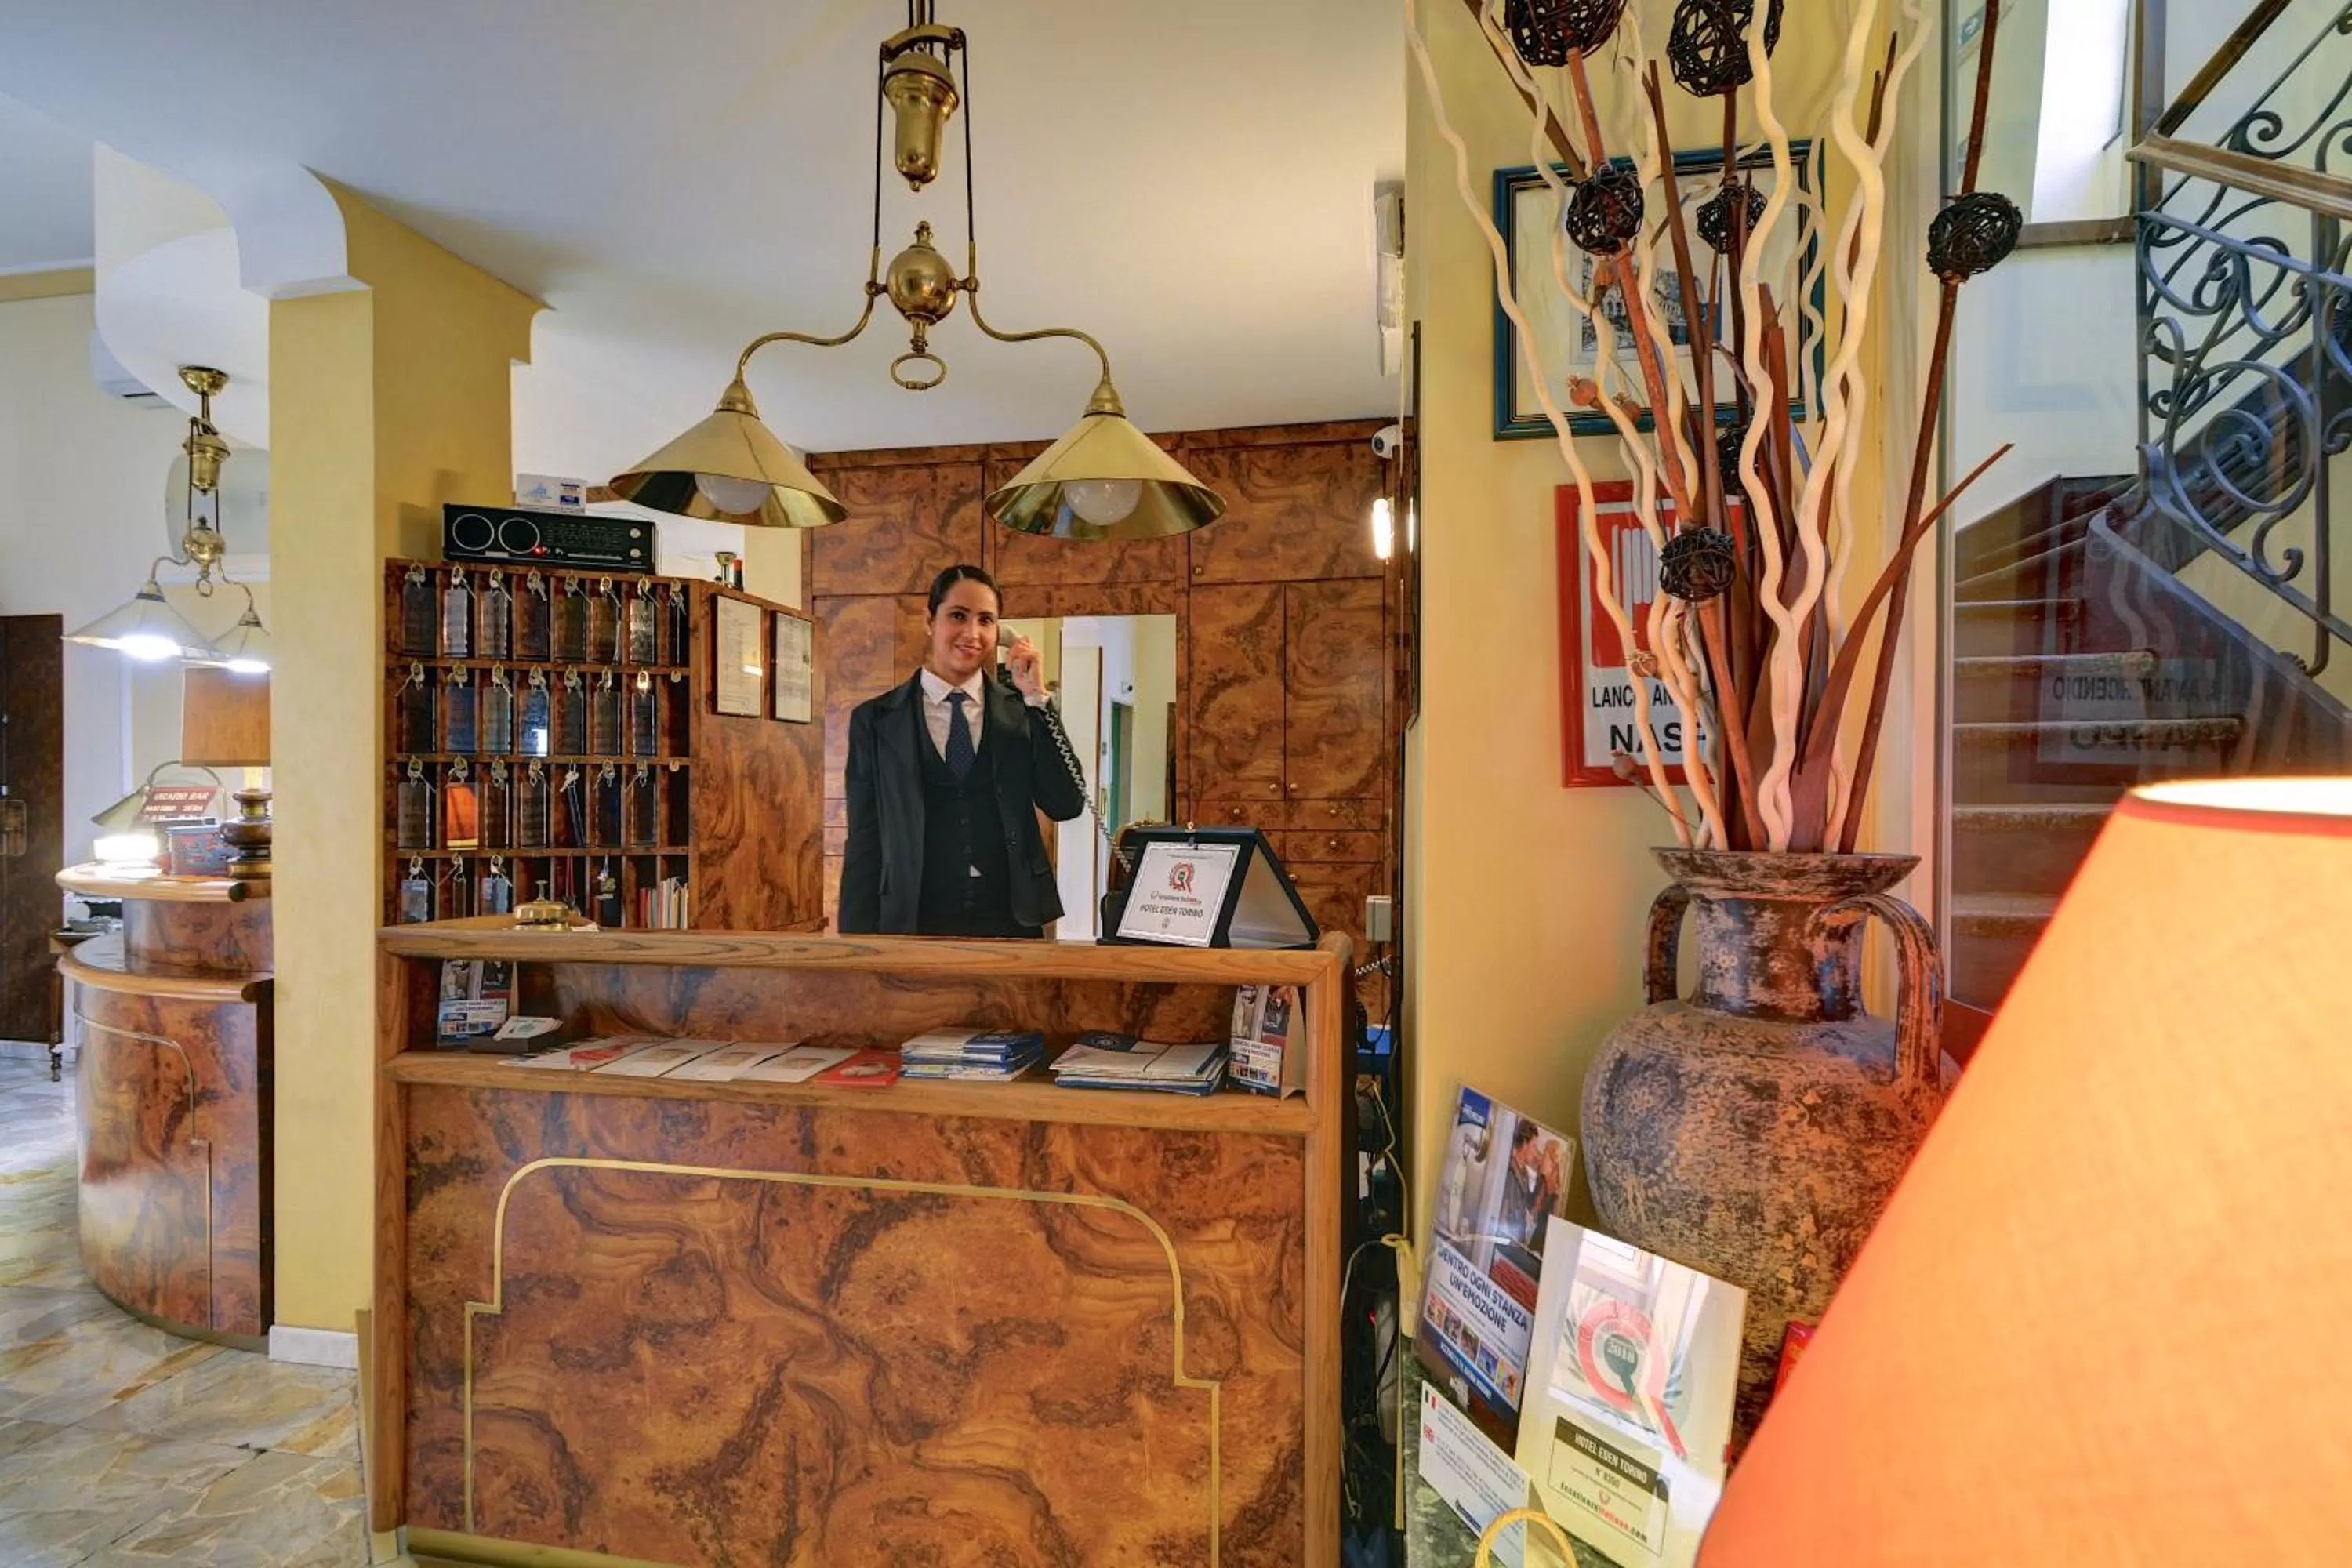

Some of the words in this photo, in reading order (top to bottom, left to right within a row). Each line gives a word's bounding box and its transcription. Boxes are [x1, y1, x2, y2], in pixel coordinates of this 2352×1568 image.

[1592, 684, 1636, 708] LANC
[1139, 903, 1159, 913] HOTEL
[1178, 907, 1203, 918] TORINO
[1450, 1272, 1508, 1333] UN'EMOZIONE
[1470, 1270, 1491, 1298] OGNI
[1492, 1290, 1528, 1331] STANZA
[1575, 1432, 1598, 1455] HOTEL
[1599, 1446, 1620, 1469] EDEN
[1621, 1457, 1648, 1484] TORINO
